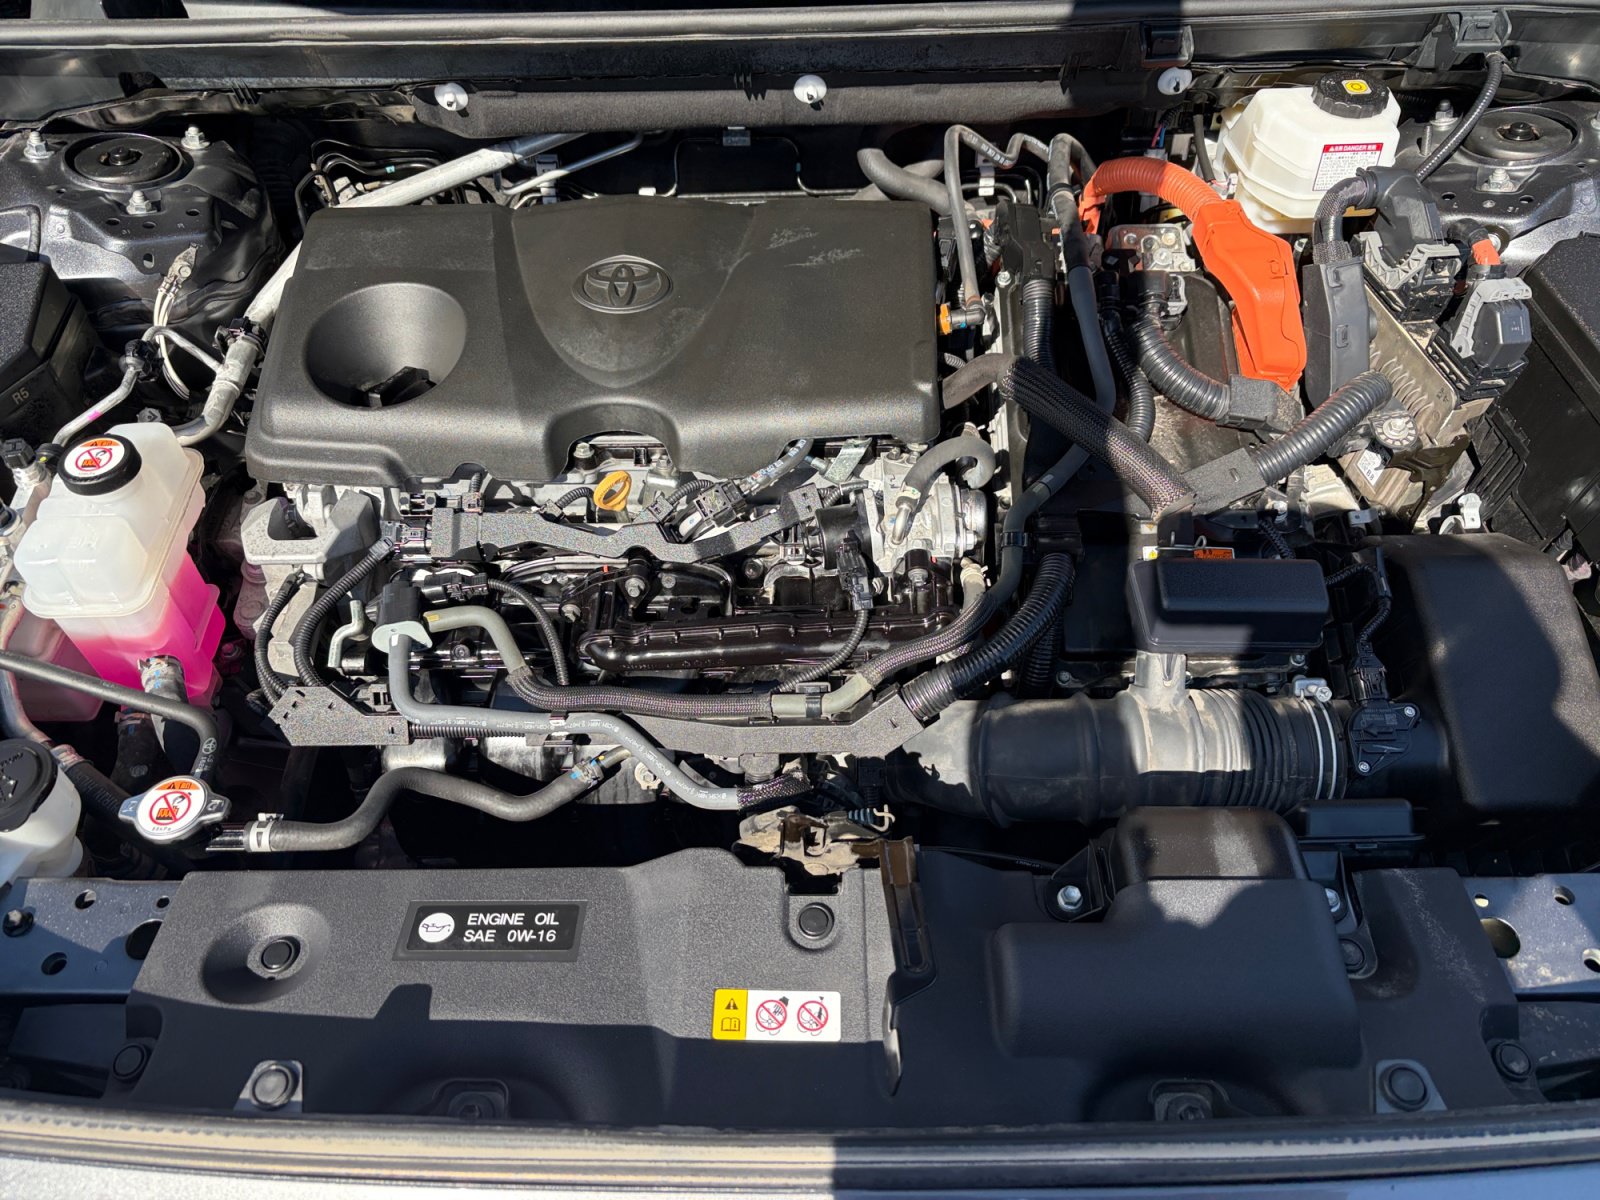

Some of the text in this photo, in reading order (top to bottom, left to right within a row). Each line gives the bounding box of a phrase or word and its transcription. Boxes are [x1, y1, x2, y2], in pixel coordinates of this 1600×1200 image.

[11, 386, 30, 405] R5
[467, 912, 560, 926] ENGINE OIL
[463, 929, 557, 943] SAE 0W-16
